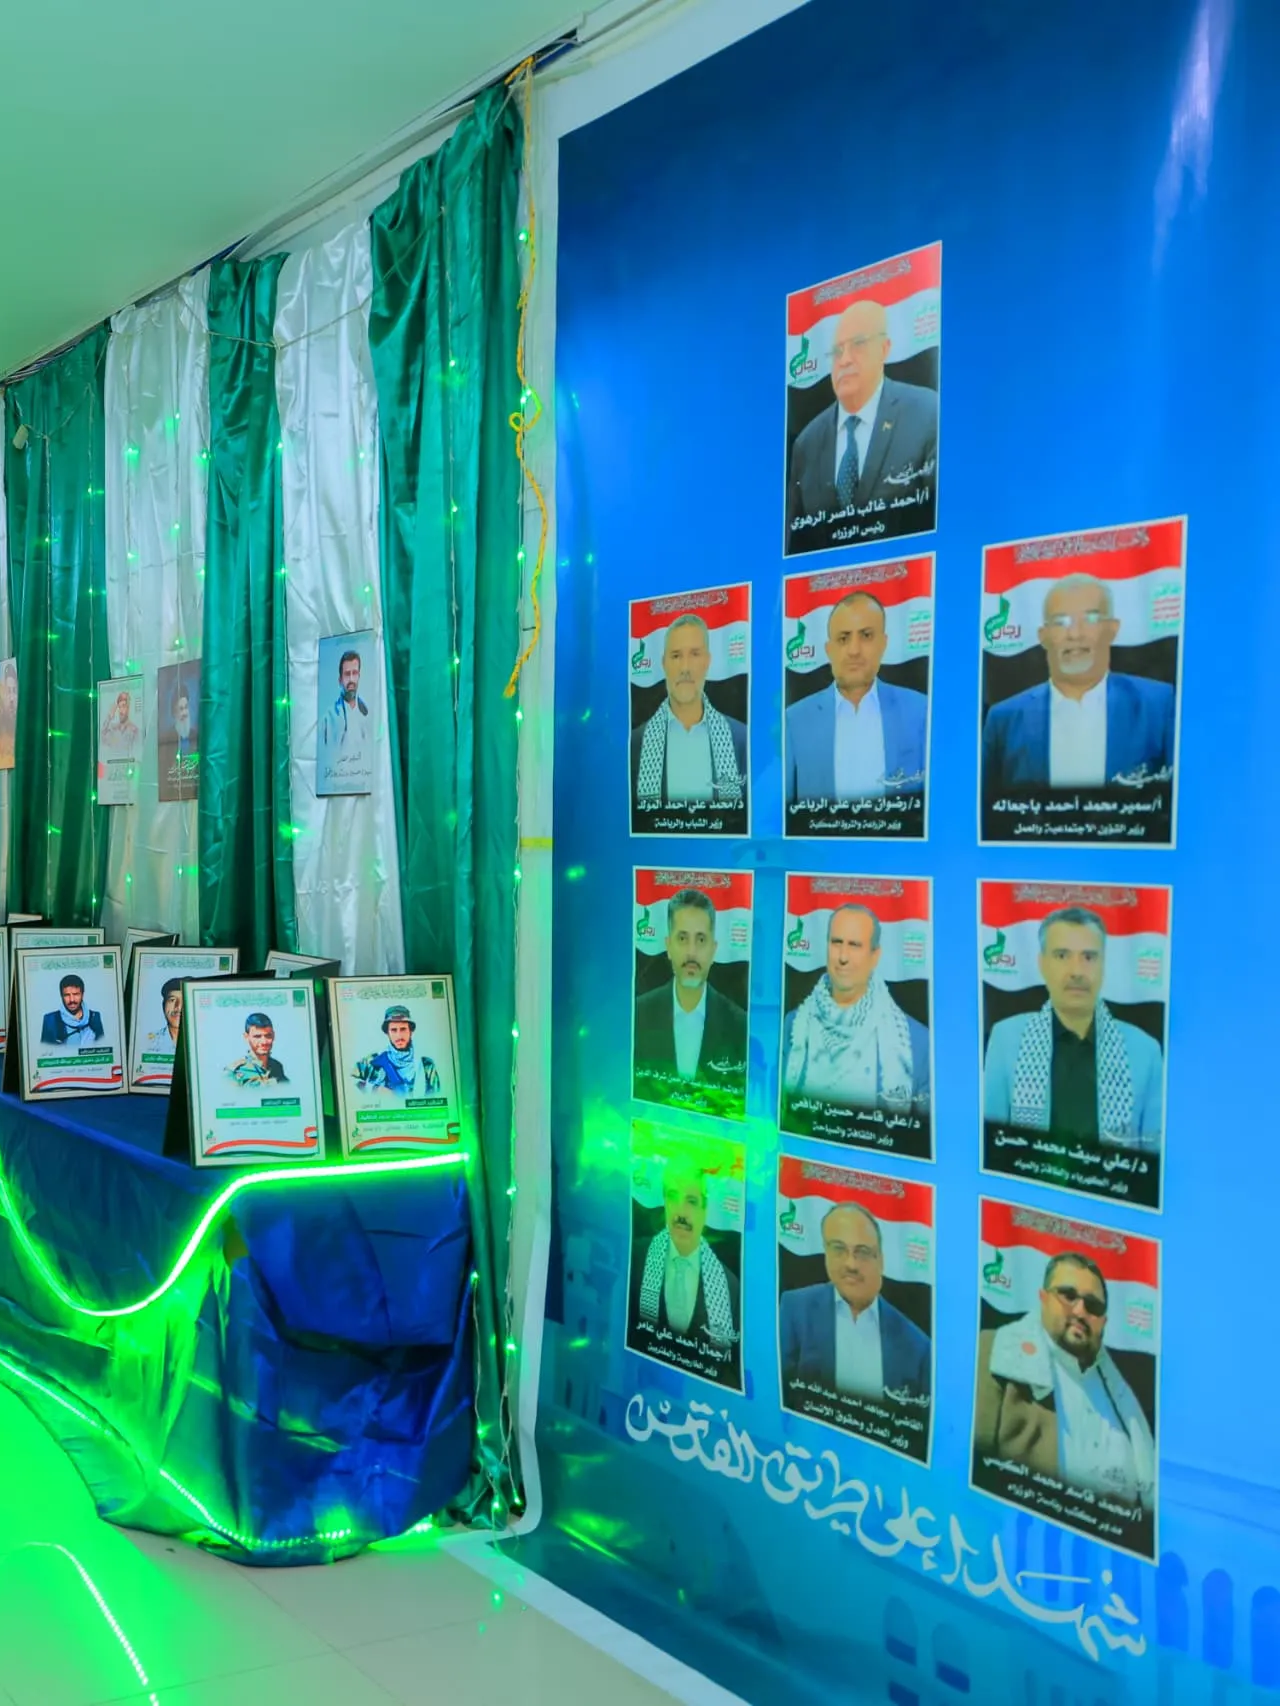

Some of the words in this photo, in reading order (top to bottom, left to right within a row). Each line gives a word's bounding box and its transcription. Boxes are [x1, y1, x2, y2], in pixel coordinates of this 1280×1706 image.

[828, 503, 855, 523] ناصر
[857, 499, 887, 517] غالب
[790, 510, 826, 532] الرهوي
[860, 520, 885, 536] رئيس
[831, 525, 859, 541] الوزراء
[688, 799, 706, 814] علي
[829, 796, 850, 814] علي
[851, 796, 873, 814] علي
[1045, 794, 1080, 812] أحمد
[1083, 799, 1118, 812] محمد
[685, 818, 708, 830] الشباب
[1014, 822, 1042, 836] والعمل
[790, 1096, 823, 1111] اليافعي
[824, 1103, 854, 1117] حسين
[856, 1110, 884, 1123] قاسم
[876, 1134, 894, 1147] وزير
[994, 1129, 1029, 1147] حسن
[1032, 1138, 1066, 1155] محمد
[1068, 1143, 1101, 1164] سيف
[636, 1320, 655, 1333] عامر
[656, 1327, 673, 1341] علي
[675, 1335, 698, 1349] أحمد
[789, 1378, 806, 1390] علي
[835, 1410, 865, 1431] وحقوق
[866, 1422, 890, 1438] العدل
[625, 1393, 760, 1484] القدس
[890, 1434, 909, 1449] وزير
[761, 1441, 870, 1535] طريق
[1032, 1475, 1063, 1491] محمد
[1065, 1487, 1096, 1504] قاسم
[857, 1484, 941, 1557] على
[1064, 1505, 1098, 1526] مكتب
[922, 1514, 1147, 1662] شهداء
